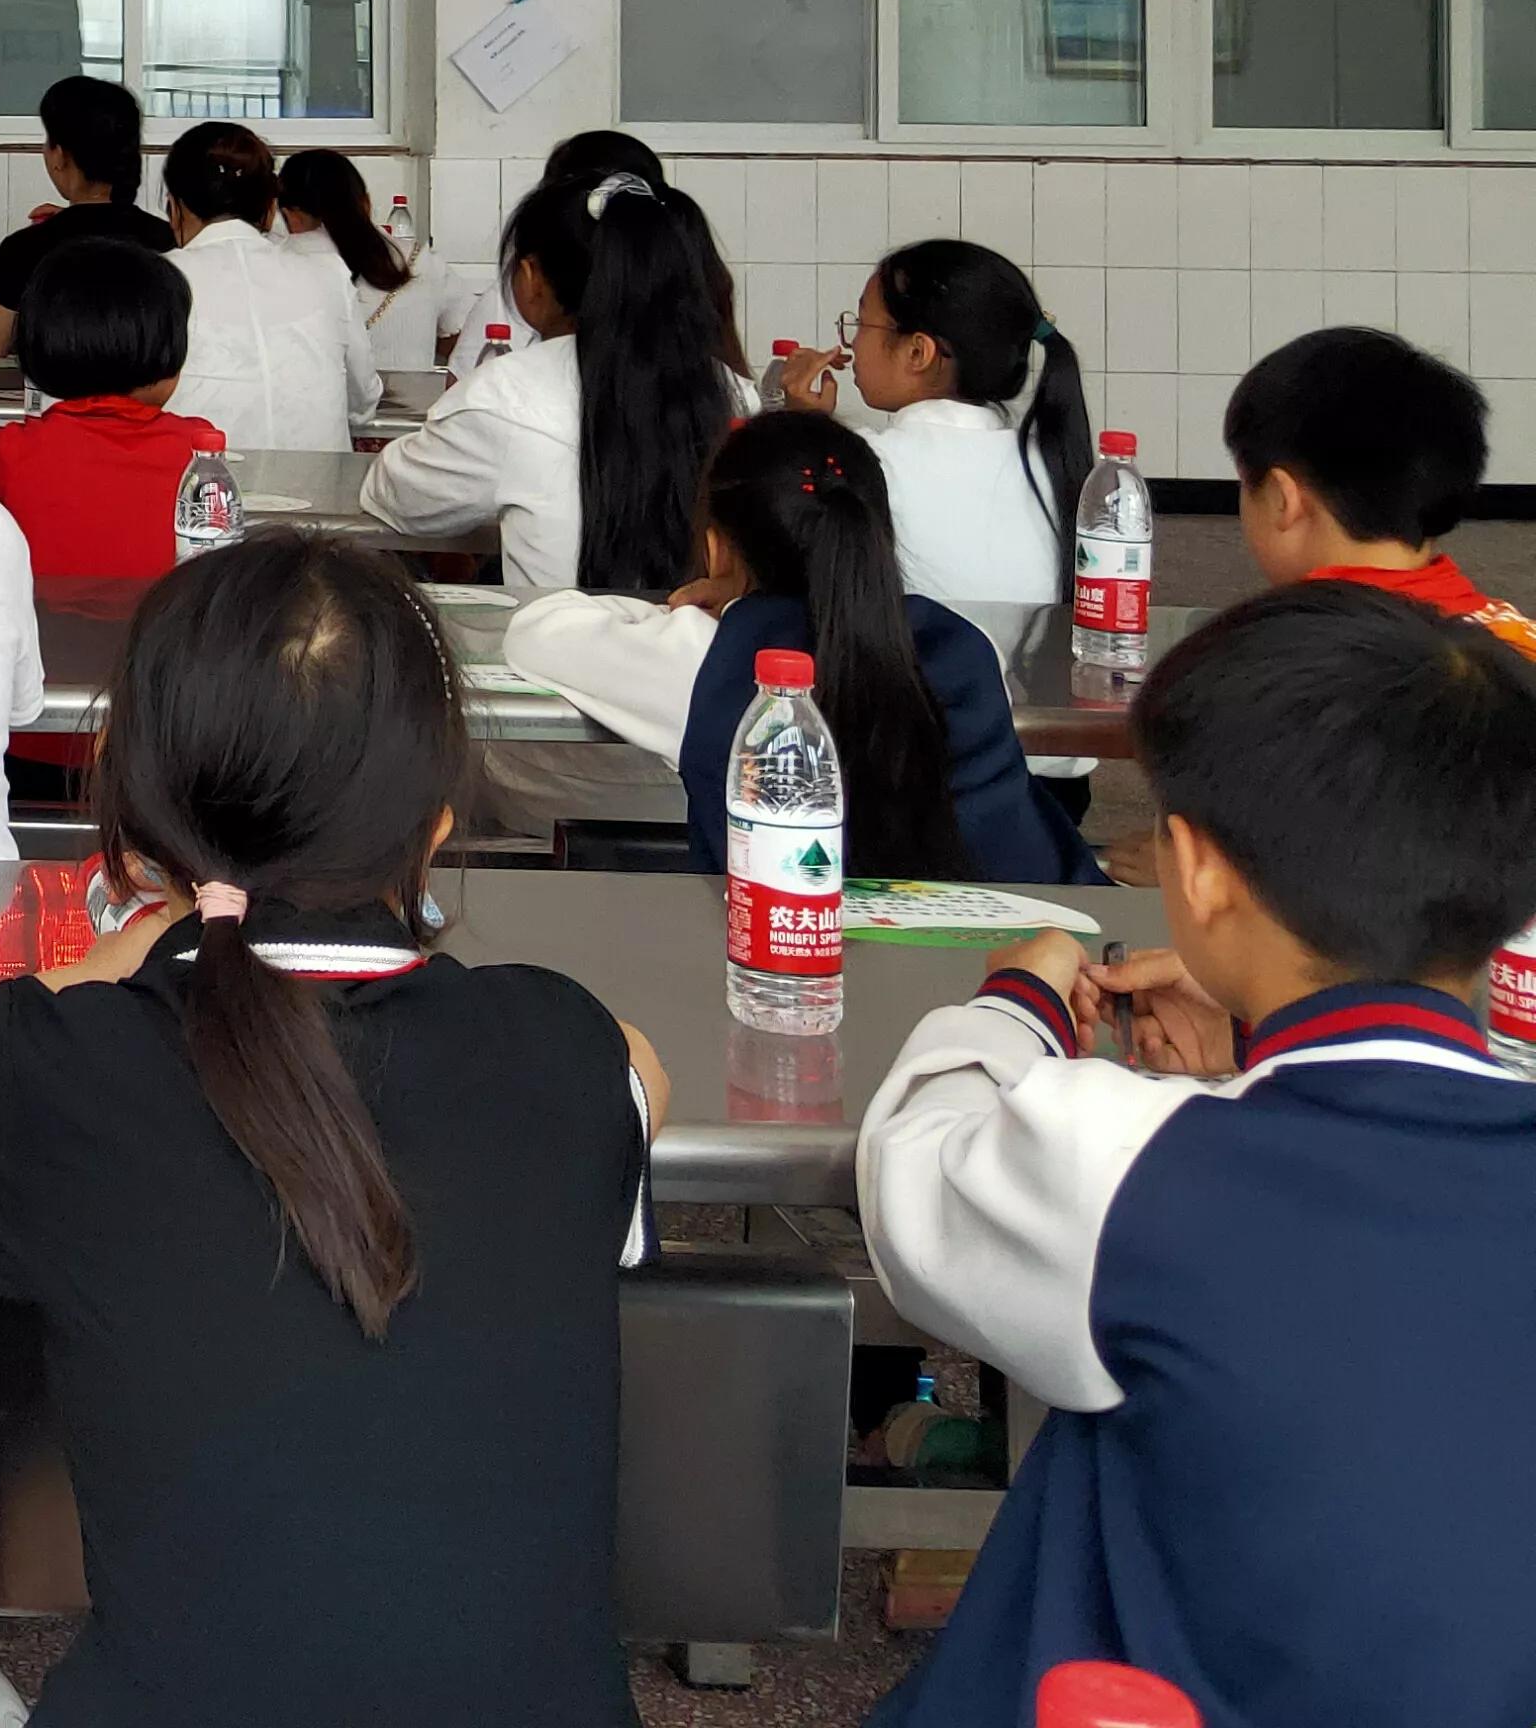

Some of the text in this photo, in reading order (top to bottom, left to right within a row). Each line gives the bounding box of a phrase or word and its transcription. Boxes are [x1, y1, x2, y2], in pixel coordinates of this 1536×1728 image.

[769, 906, 841, 932] 农夫山
[770, 931, 816, 946] NONGFU
